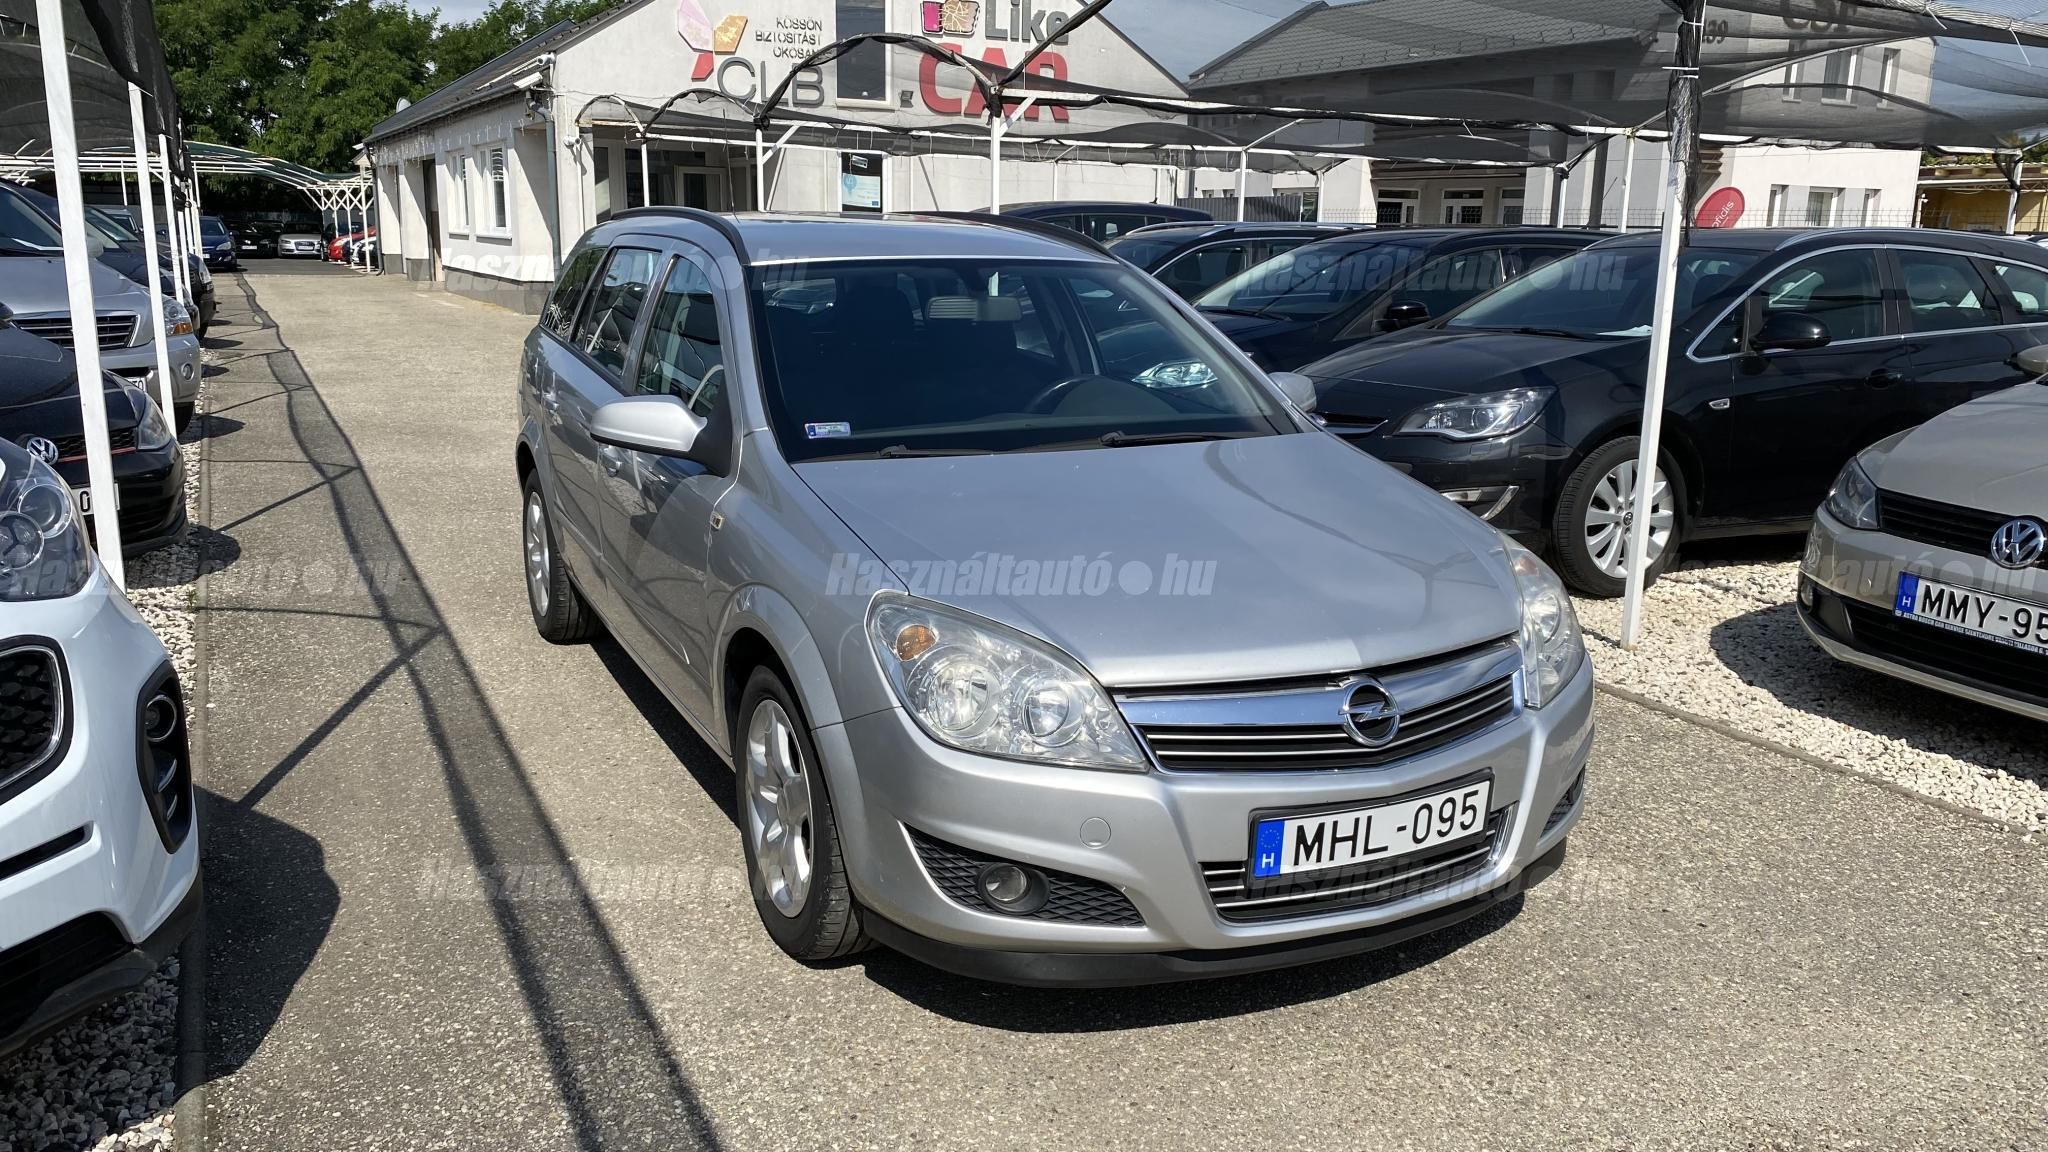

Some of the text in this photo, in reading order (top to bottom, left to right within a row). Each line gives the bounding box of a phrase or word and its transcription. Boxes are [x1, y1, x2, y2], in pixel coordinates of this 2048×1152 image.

[985, 0, 1069, 45] Like
[717, 57, 824, 108] CLB
[919, 43, 1069, 123] CAR
[1902, 595, 1912, 608] H
[1293, 789, 1480, 867] MHL-095
[1261, 852, 1275, 869] H
